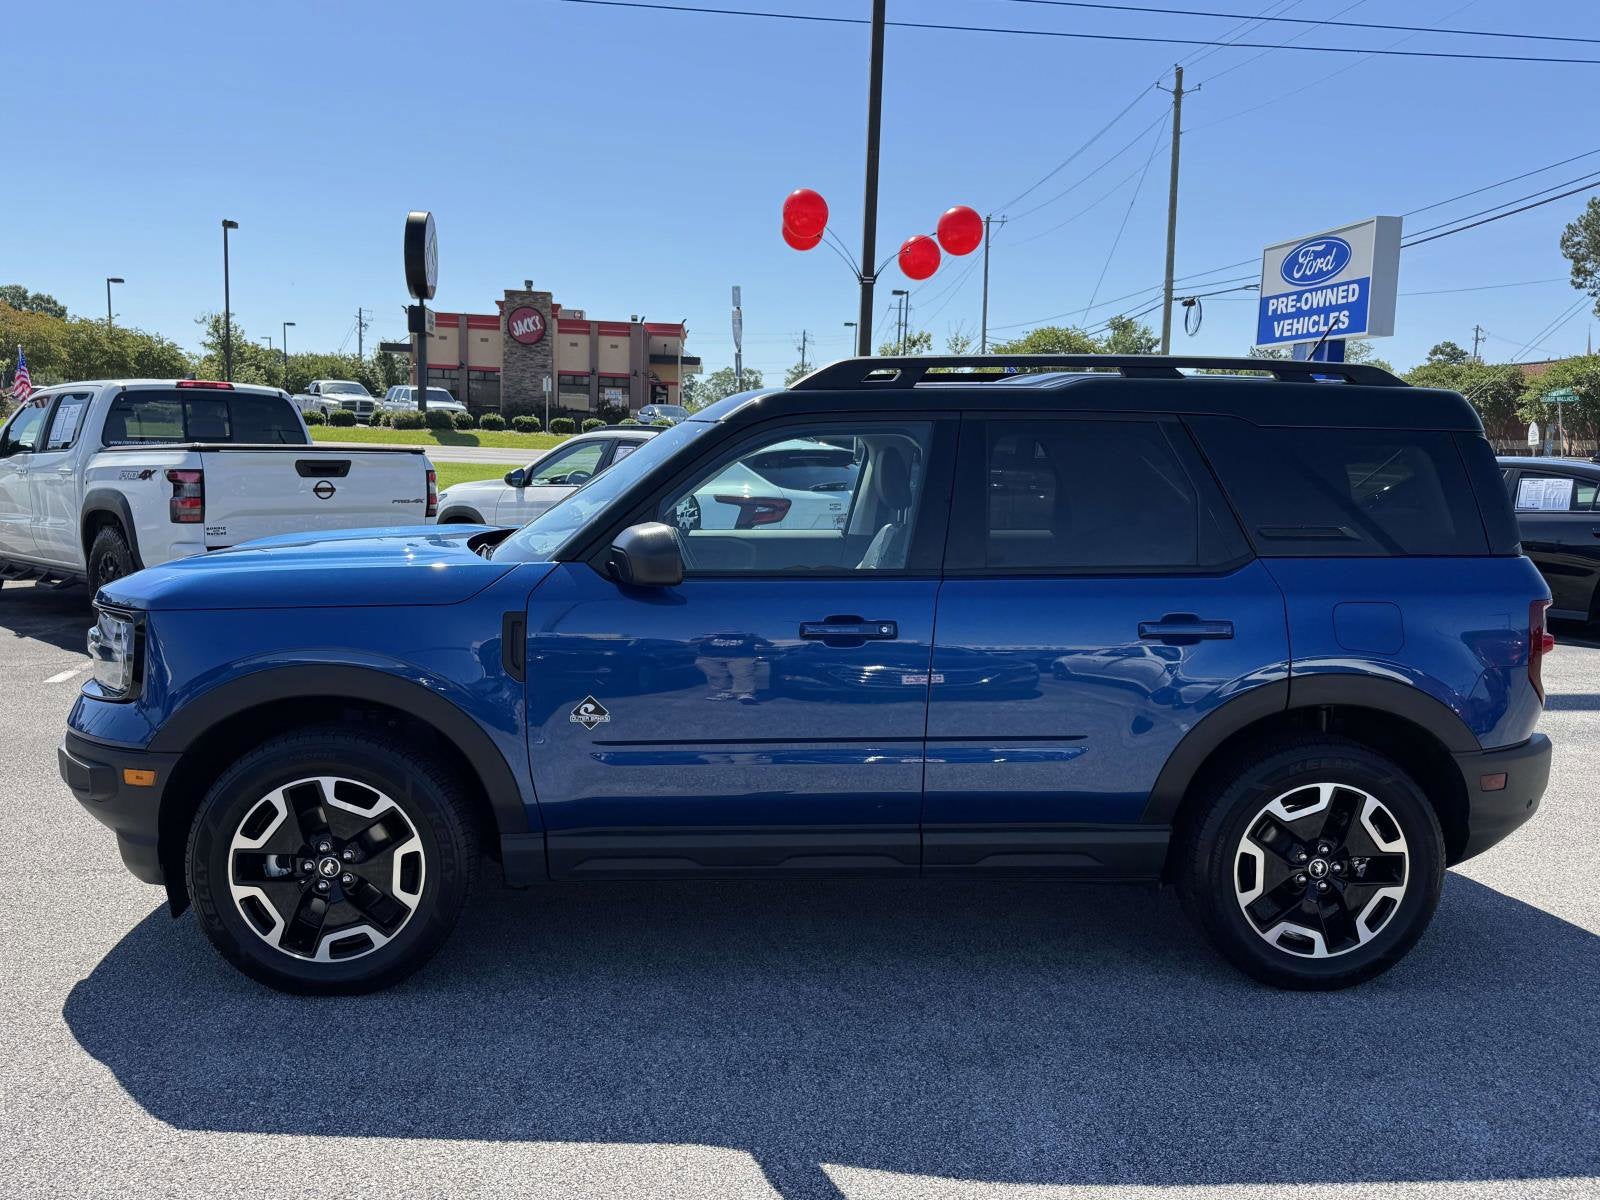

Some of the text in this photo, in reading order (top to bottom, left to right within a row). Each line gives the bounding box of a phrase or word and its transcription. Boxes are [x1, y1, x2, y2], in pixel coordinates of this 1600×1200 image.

[1293, 244, 1337, 279] Ford
[1268, 283, 1360, 316] PRE-OWNED
[1273, 310, 1350, 338] VEHICLES
